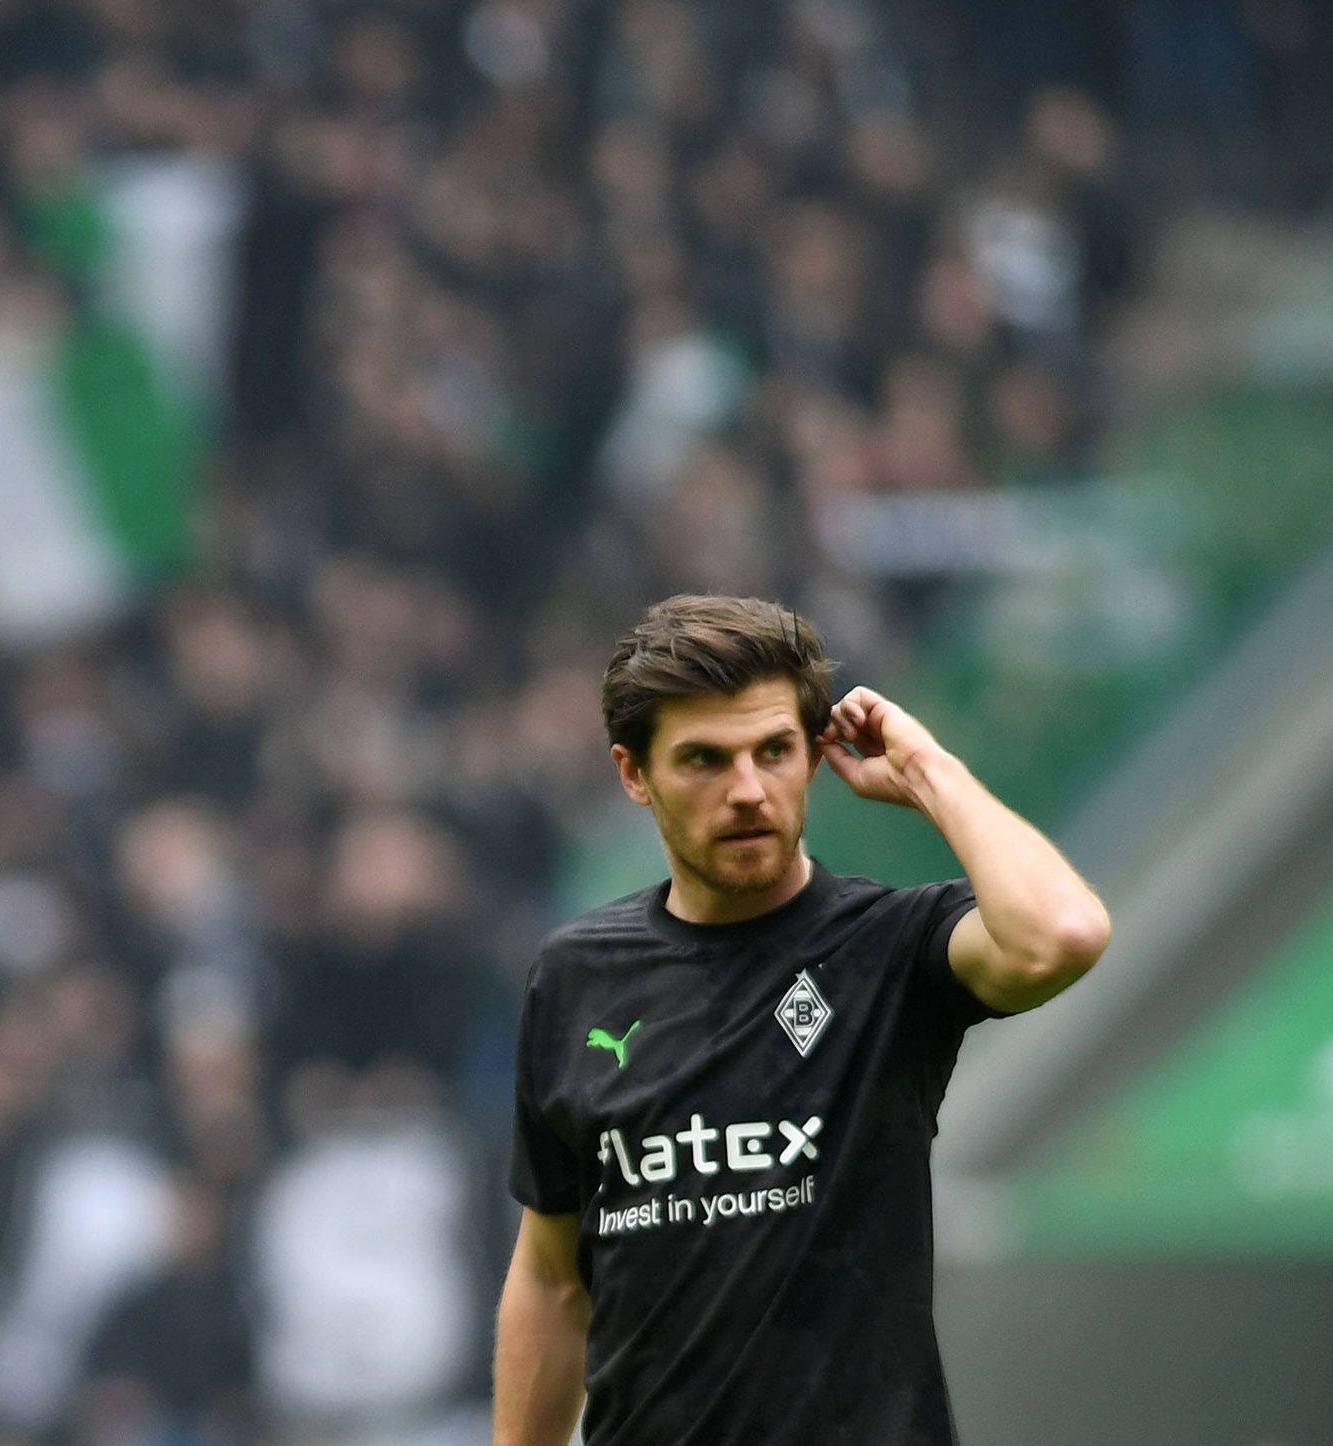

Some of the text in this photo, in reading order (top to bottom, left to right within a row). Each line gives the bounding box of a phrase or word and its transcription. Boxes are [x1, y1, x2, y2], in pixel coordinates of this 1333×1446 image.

[598, 1175, 816, 1237] Invest in yourself
